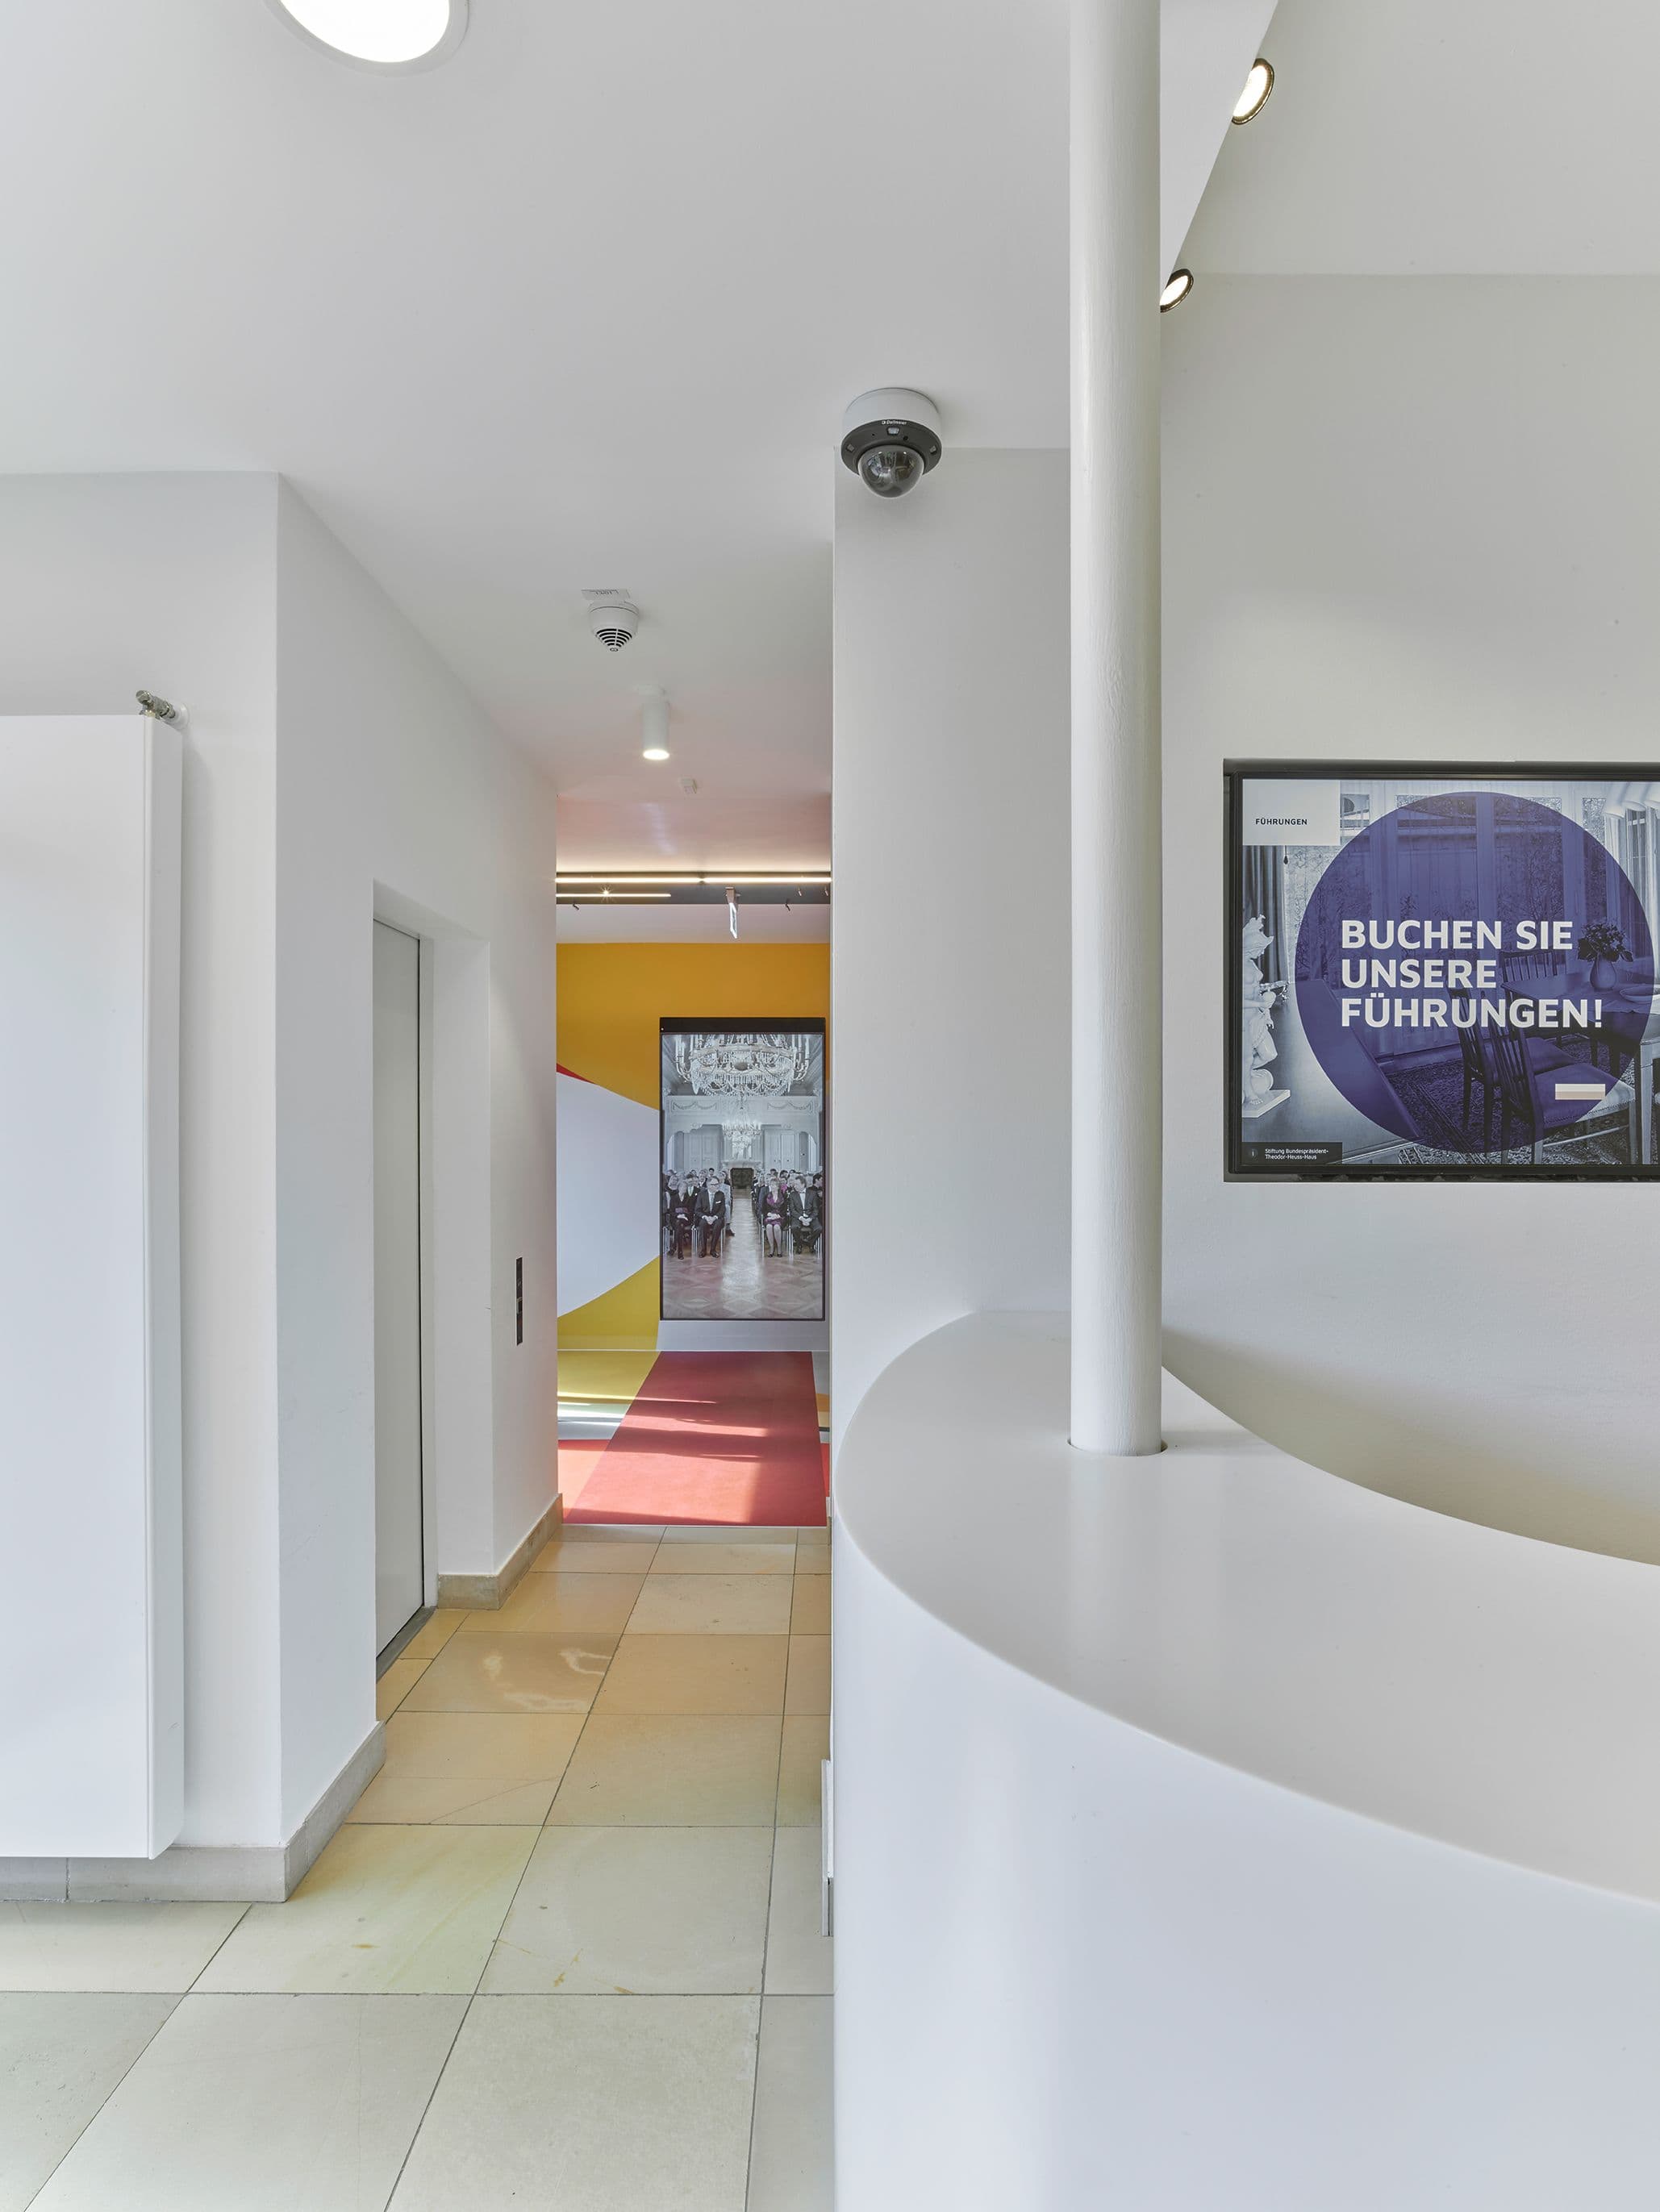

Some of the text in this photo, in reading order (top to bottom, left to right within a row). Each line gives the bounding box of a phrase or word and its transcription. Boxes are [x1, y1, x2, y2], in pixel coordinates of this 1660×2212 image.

[1255, 817, 1308, 826] FÜHRUNGEN
[1341, 919, 1573, 950] BUCHEN SIE
[1341, 959, 1496, 989] UNSERE
[1341, 992, 1602, 1028] FÜHRUNGEN!
